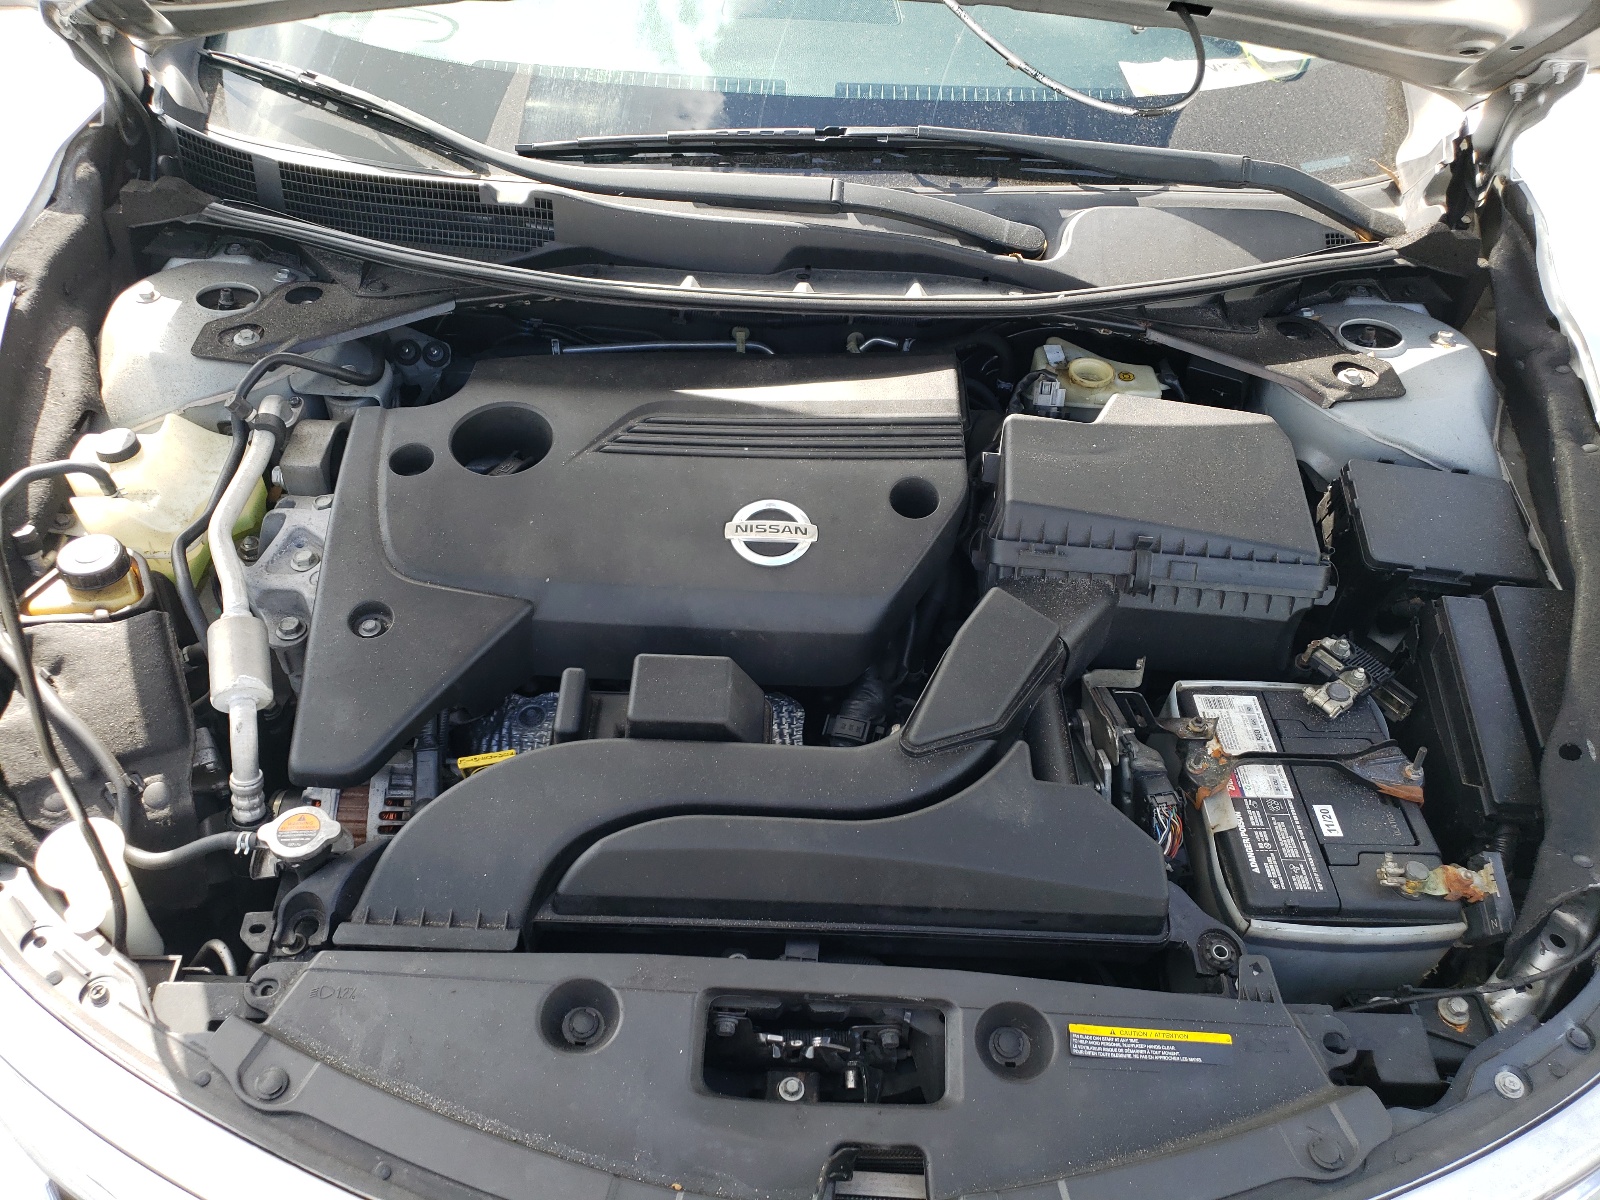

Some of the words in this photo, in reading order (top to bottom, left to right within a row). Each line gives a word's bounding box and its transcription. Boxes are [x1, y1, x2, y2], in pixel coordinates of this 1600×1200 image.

[734, 524, 808, 536] NISSAN
[1320, 808, 1337, 834] 11/20
[1154, 1032, 1189, 1040] ATTENTION
